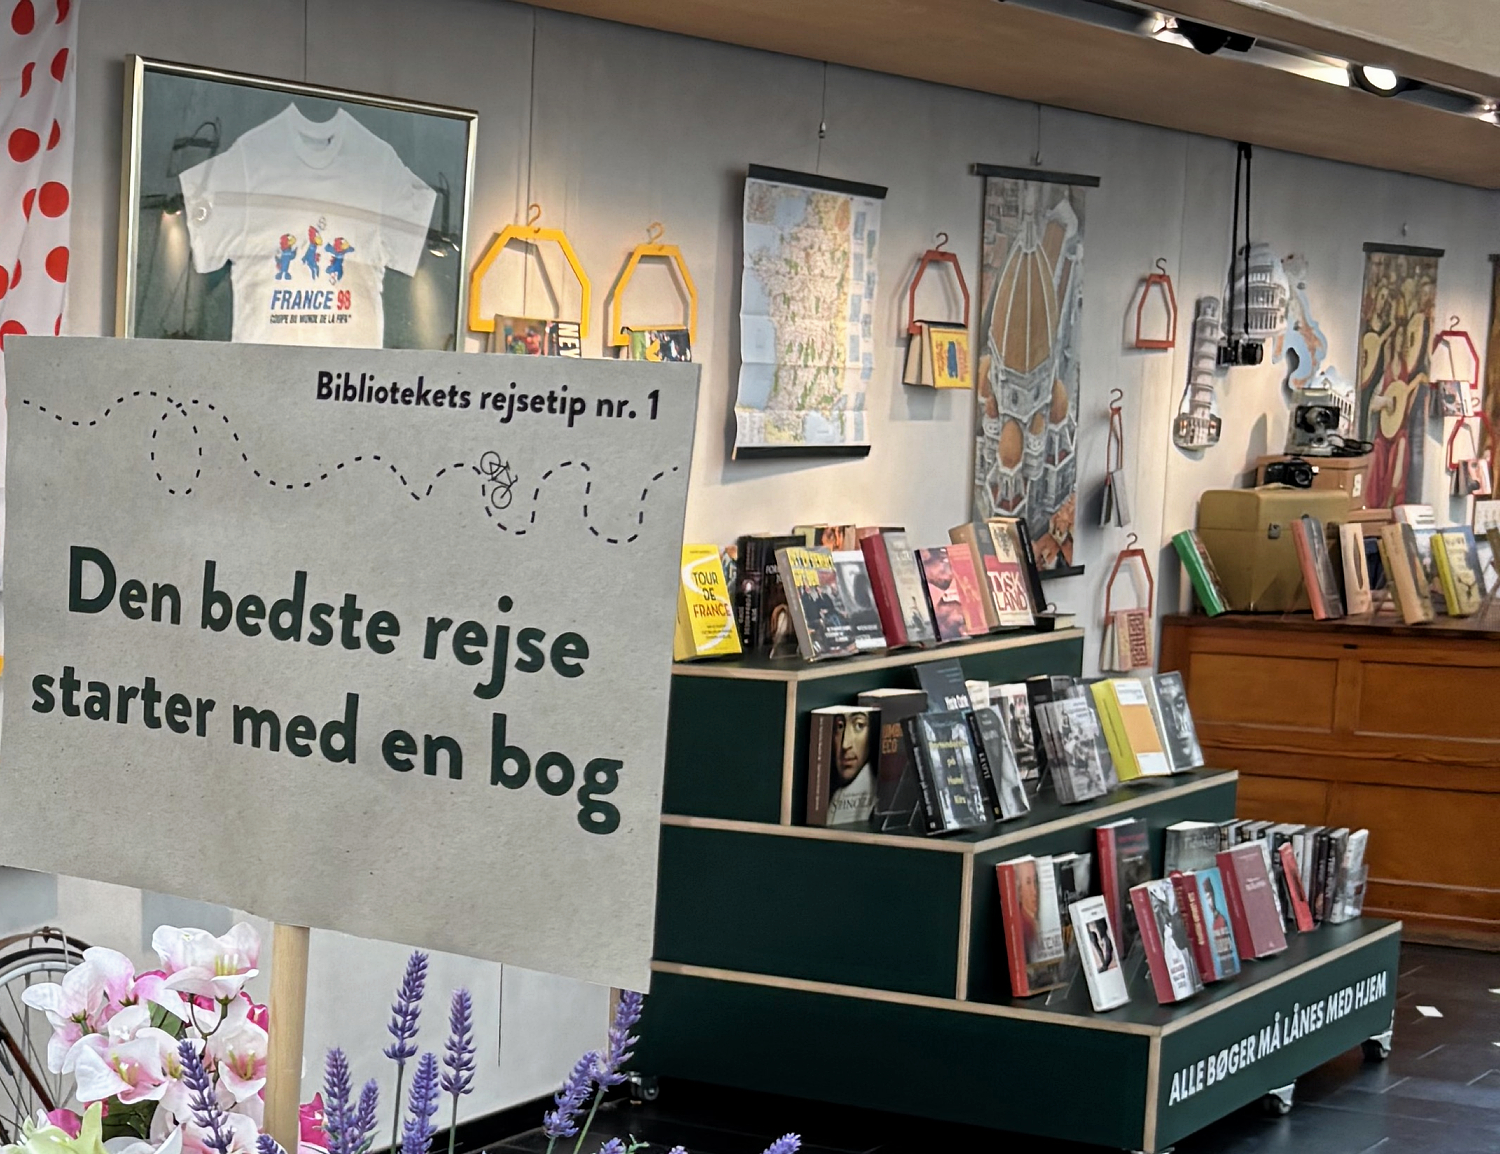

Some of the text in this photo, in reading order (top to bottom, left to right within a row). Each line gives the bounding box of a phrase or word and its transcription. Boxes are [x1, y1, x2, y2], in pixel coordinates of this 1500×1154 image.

[270, 289, 335, 311] FRANCE
[316, 372, 659, 427] Bibliotekets rejsetip nr. 1
[692, 571, 718, 586] TOUR
[987, 571, 1024, 593] TYSK
[702, 588, 716, 601] DE
[992, 592, 1028, 611] LAND
[693, 603, 731, 618] FRANCE
[68, 545, 590, 700] Den bedste rejse
[31, 666, 623, 835] starter med en bog
[1169, 970, 1387, 1106] ALLE BØGER MÅ LÅNES MED HJEM
